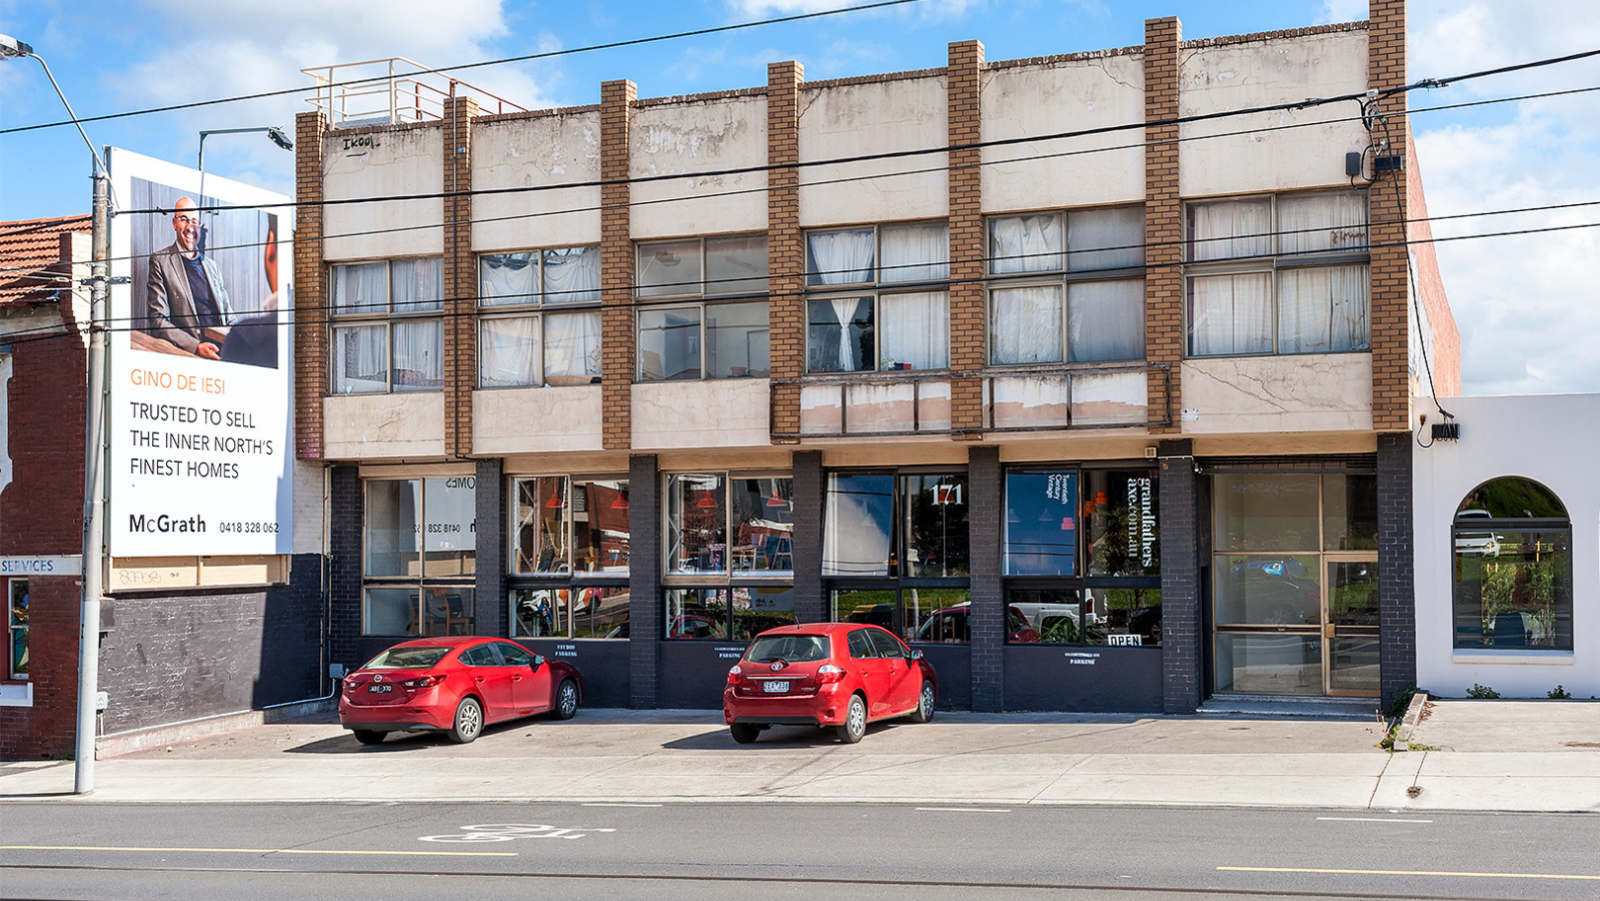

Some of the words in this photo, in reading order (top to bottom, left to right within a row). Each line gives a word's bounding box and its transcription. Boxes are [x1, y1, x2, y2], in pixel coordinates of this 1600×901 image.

[130, 368, 172, 389] GINO
[177, 373, 197, 392] DE
[201, 376, 225, 395] IESI
[130, 401, 198, 424] TRUSTED
[202, 408, 222, 426] TO
[226, 410, 256, 429] SELL
[130, 430, 160, 448] THE
[165, 432, 210, 452] INNER
[214, 435, 274, 456] NORTH'S
[130, 457, 183, 477] FINEST
[187, 460, 239, 480] HOMES
[930, 484, 963, 505] 171
[129, 513, 207, 534] McGrath
[219, 521, 242, 534] 0418
[244, 522, 261, 534] 328
[263, 522, 280, 534] 062
[1137, 478, 1156, 567] grandfathers
[1109, 635, 1141, 647] OPEN
